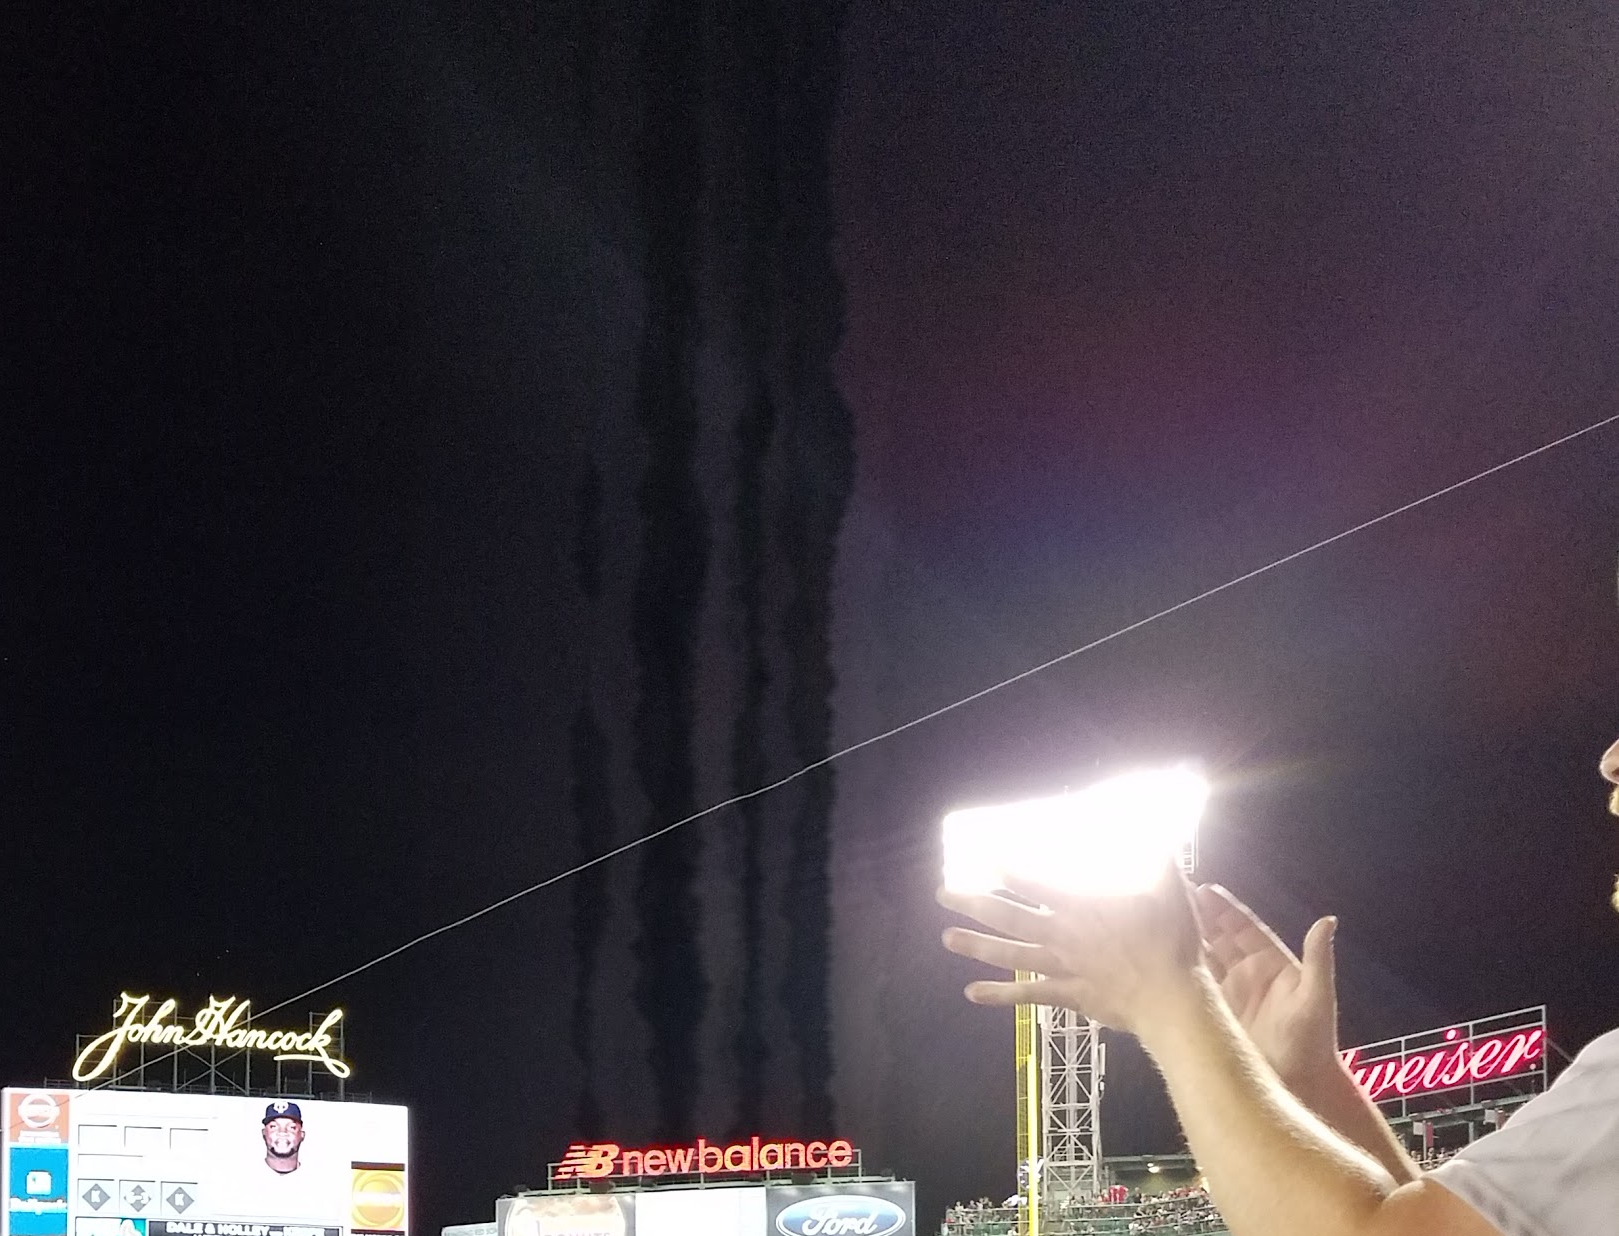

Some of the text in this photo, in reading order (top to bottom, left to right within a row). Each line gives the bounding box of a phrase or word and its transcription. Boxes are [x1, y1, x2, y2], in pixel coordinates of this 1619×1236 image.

[72, 991, 351, 1082] John Hancock
[623, 1136, 854, 1175] new balance
[802, 1205, 878, 1236] Ford
